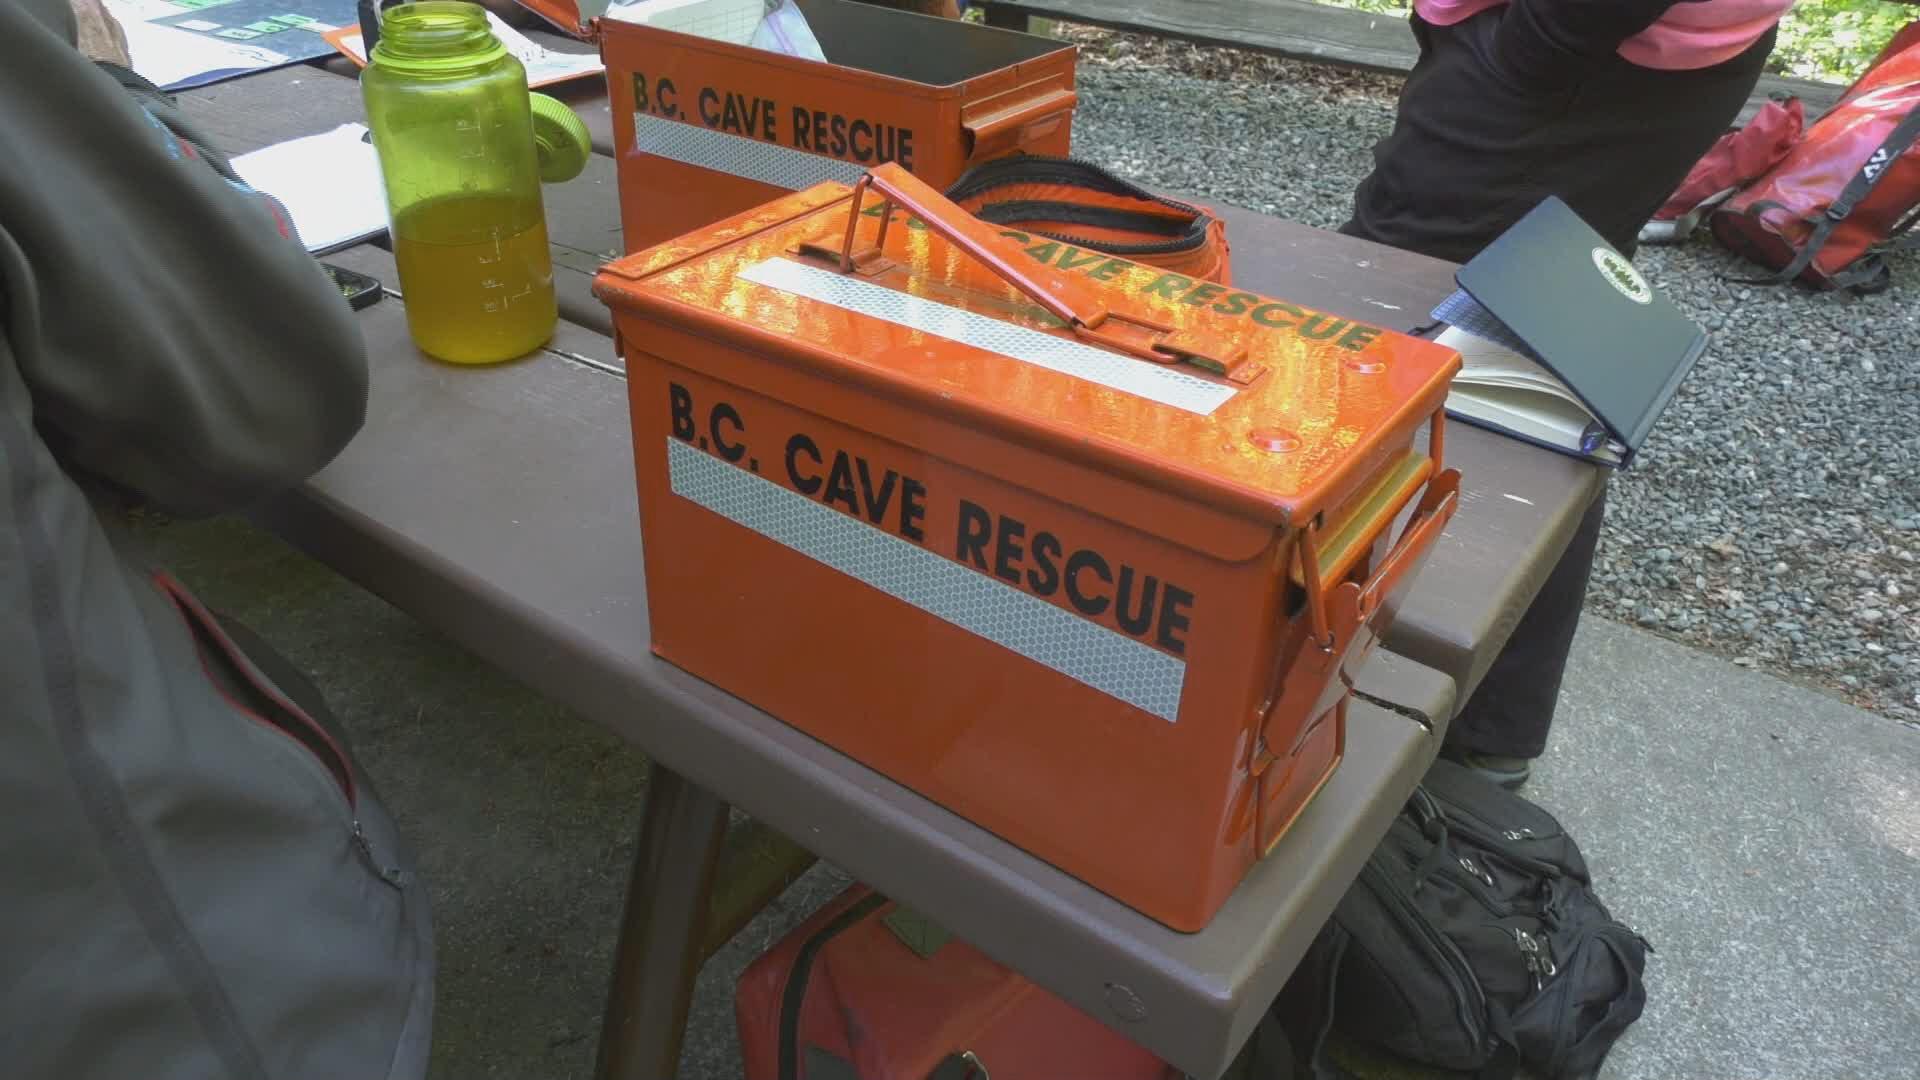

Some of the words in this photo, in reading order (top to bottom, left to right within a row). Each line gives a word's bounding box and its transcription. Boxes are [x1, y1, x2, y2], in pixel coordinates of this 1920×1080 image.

[632, 71, 685, 120] B.C.
[699, 87, 777, 141] CAVE
[792, 106, 913, 171] RESCUE
[1140, 273, 1383, 351] RESCUE
[670, 381, 758, 473] B.C.
[785, 433, 926, 542] CAVE
[957, 499, 1194, 653] RESCUE
